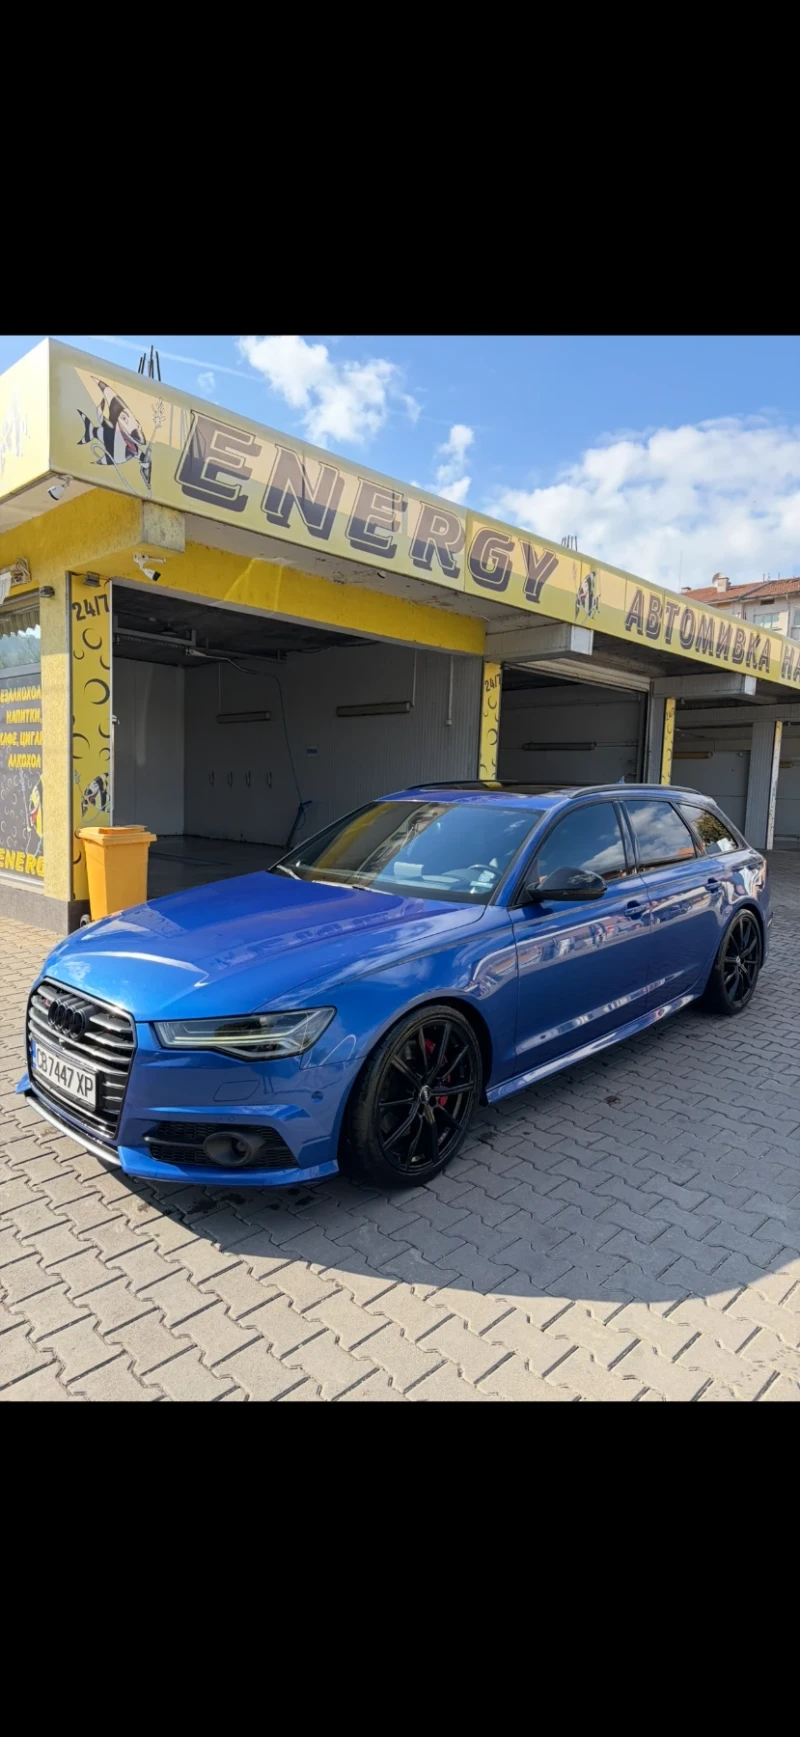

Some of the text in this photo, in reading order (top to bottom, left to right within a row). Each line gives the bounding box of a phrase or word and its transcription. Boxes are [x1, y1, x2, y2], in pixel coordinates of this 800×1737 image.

[174, 409, 559, 603] ENERGY
[72, 594, 110, 621] 24/7
[625, 588, 770, 674] АВТОМИВКА
[485, 673, 501, 692] 24/7
